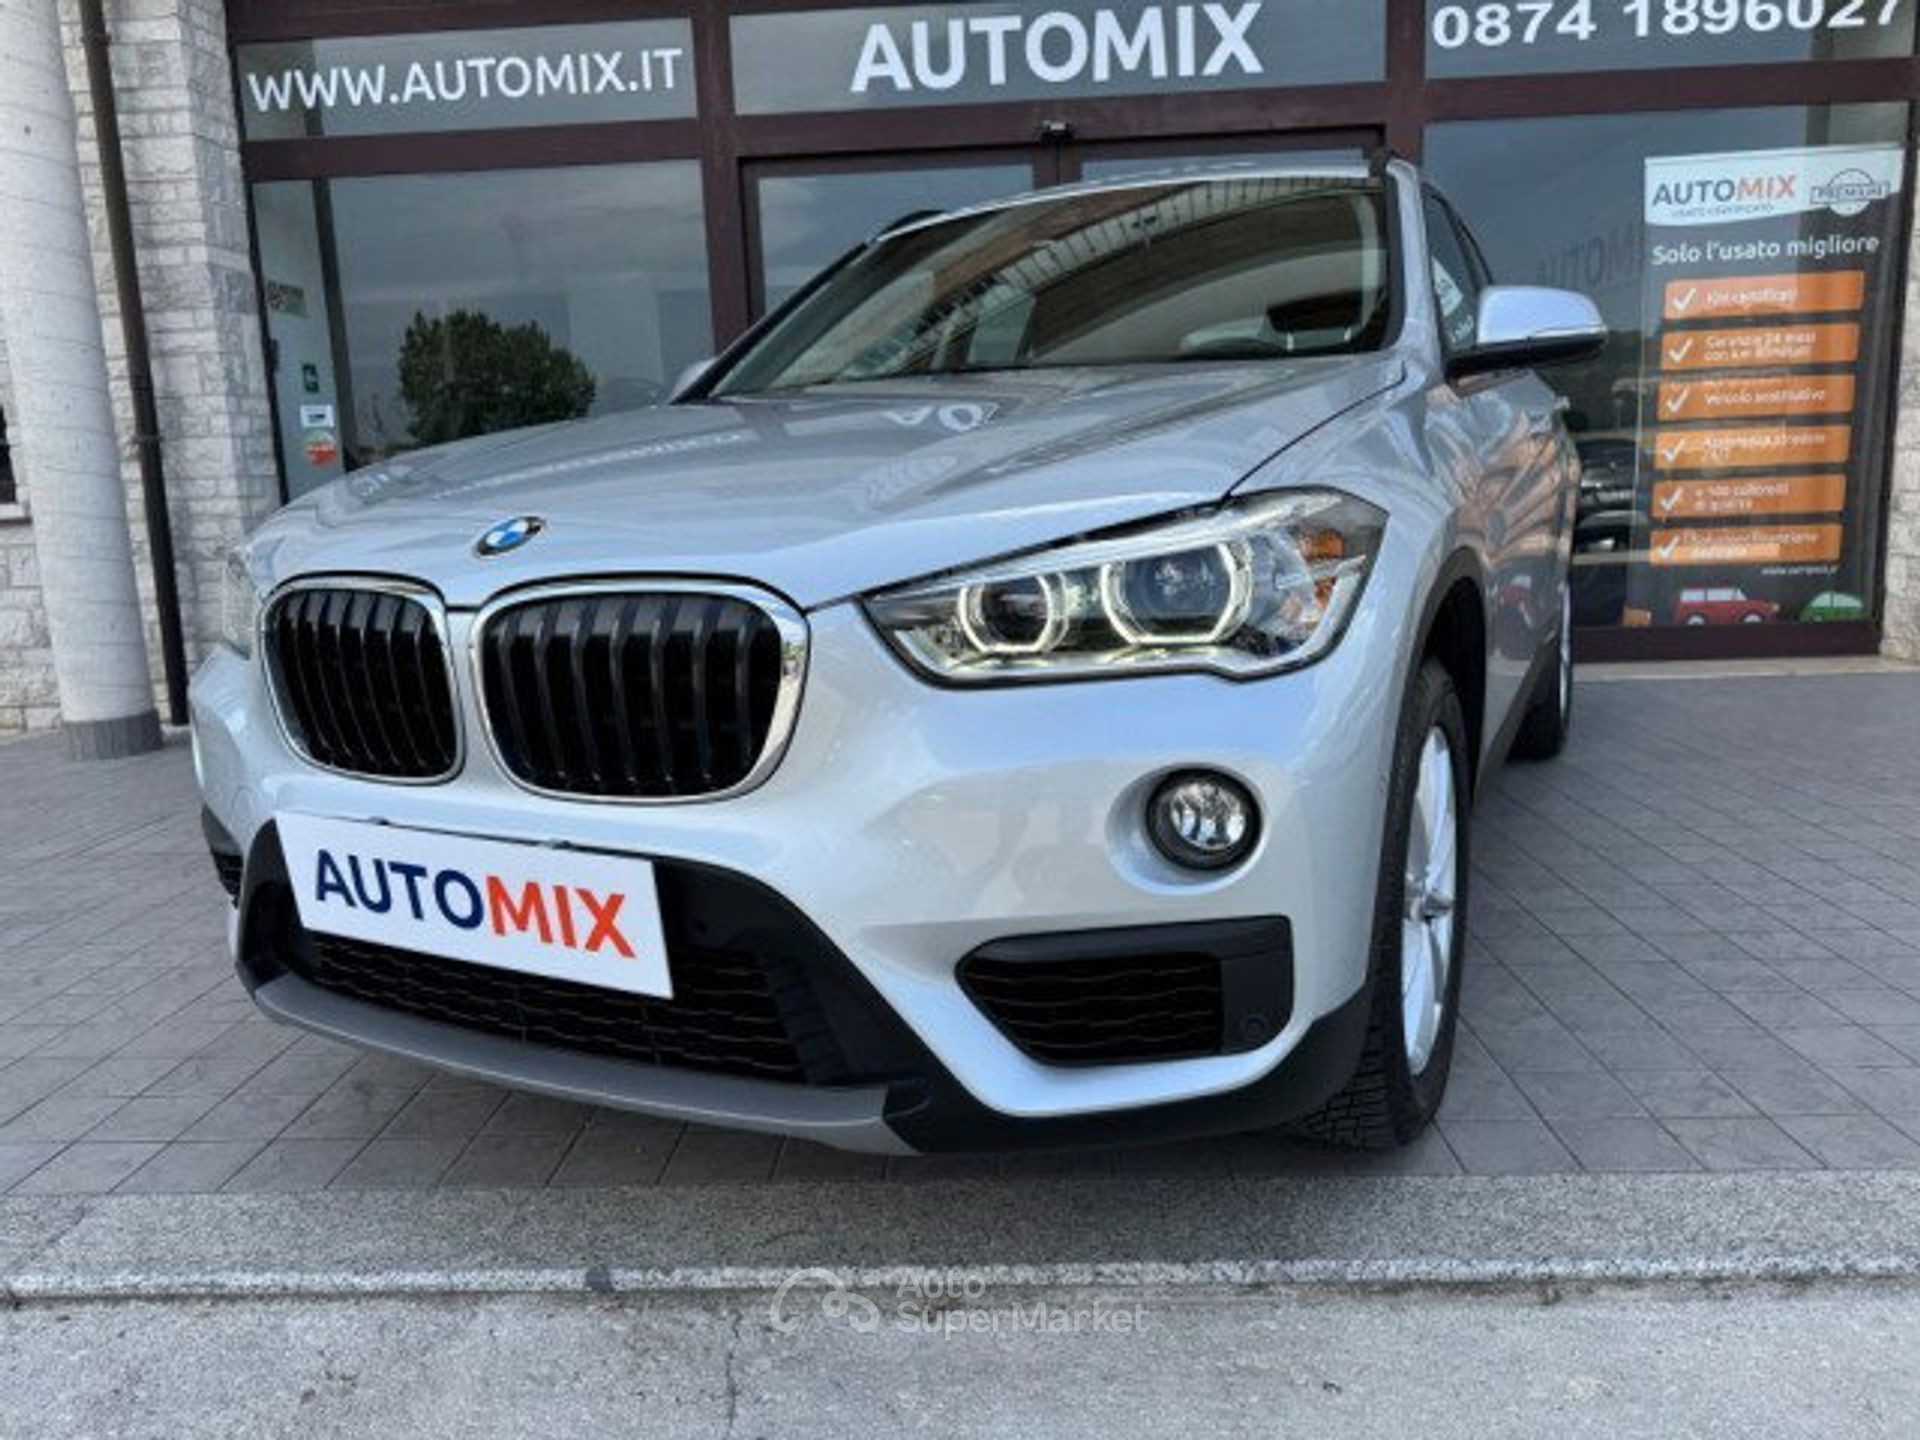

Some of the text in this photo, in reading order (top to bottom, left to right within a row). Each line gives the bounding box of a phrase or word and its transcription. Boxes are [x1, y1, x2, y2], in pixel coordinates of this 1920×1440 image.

[850, 2, 1264, 93] AUTOMIX
[1433, 0, 1901, 48] 0874 1896027
[248, 48, 683, 112] WWW.AUTOMIX.IT
[1653, 174, 1796, 206] AUTOMIX
[1652, 233, 1880, 265] Solo l'usato migliore
[315, 849, 636, 958] AUTOMIX
